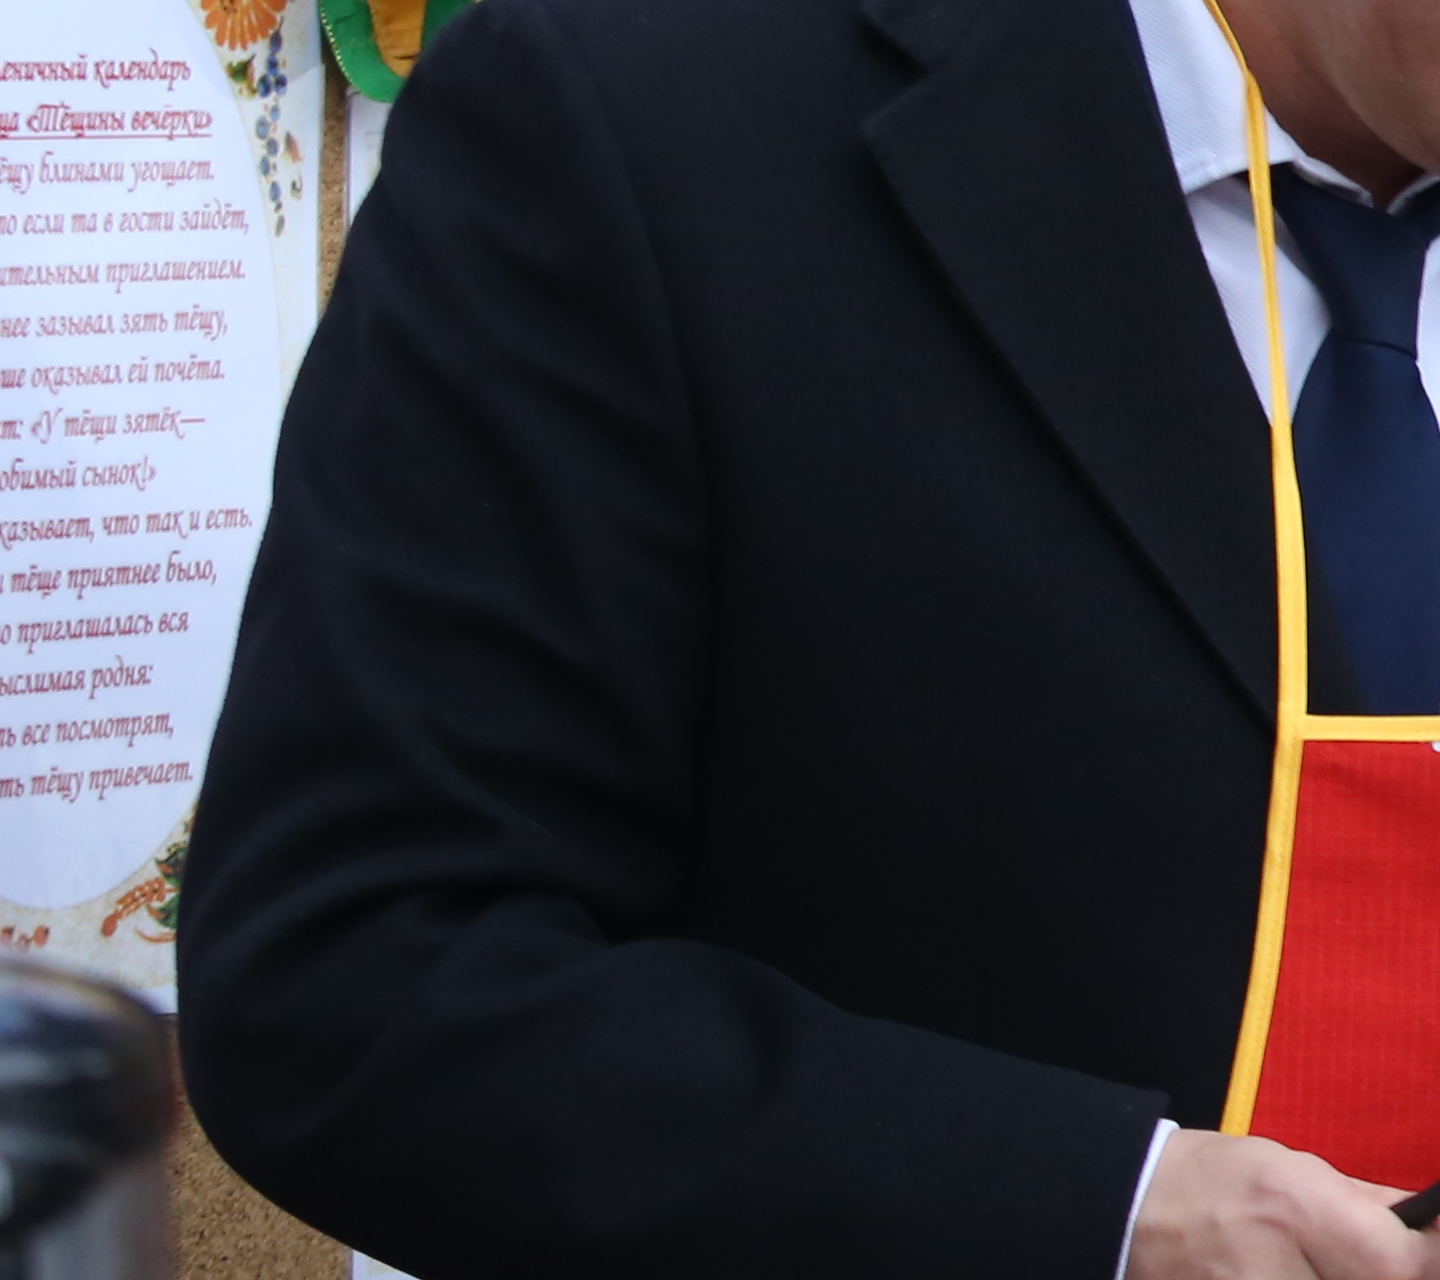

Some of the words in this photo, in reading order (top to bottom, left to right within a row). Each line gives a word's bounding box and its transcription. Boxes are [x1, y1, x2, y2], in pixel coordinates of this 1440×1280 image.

[94, 48, 191, 91] календарь
[40, 151, 124, 183] блинами
[127, 160, 214, 193] угощает.
[24, 213, 65, 234] если
[71, 213, 98, 233] та
[103, 212, 113, 233] в
[119, 211, 174, 231] гости
[179, 198, 249, 234] зайдёт,
[106, 260, 245, 294] приглашением.
[36, 314, 115, 337] зазывал
[120, 312, 168, 334] зять
[174, 304, 228, 341] тёщу,
[32, 363, 122, 395] оказывал
[128, 356, 149, 383] ей
[154, 354, 225, 381] почёта.
[64, 409, 117, 443] тёщи
[102, 514, 140, 536] что
[146, 511, 188, 539] так
[189, 510, 201, 531] и
[206, 506, 253, 529] есть.
[11, 564, 61, 599] тёще
[68, 563, 161, 600] приятнее
[166, 550, 217, 584] было,
[17, 613, 153, 654] приглашалась
[158, 610, 190, 633] вся
[88, 654, 154, 700] родня:
[22, 722, 50, 745] все
[56, 713, 174, 747] посмотрят,
[30, 766, 84, 803] тёщу
[89, 760, 194, 801] привечает.
